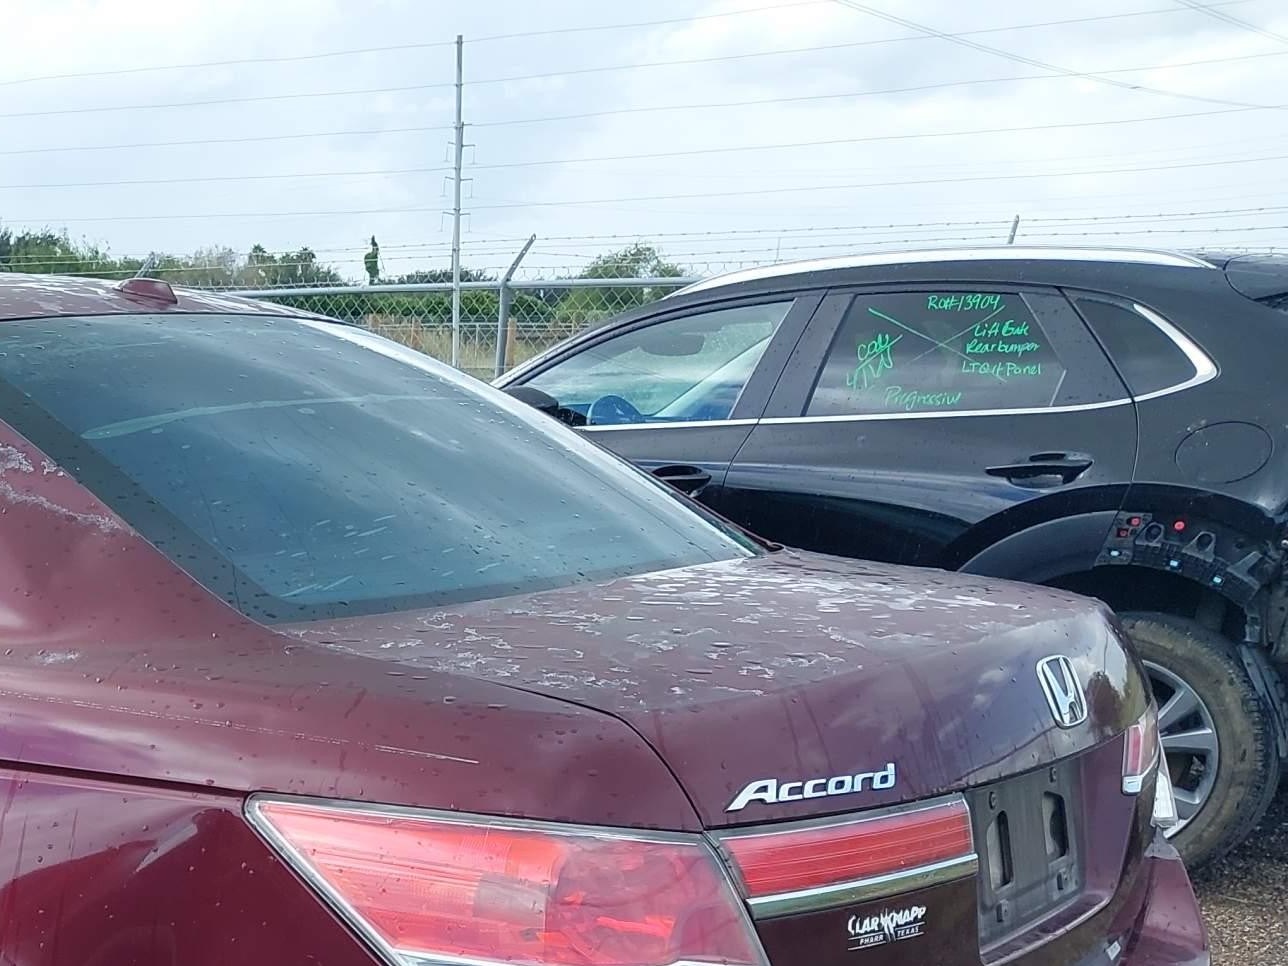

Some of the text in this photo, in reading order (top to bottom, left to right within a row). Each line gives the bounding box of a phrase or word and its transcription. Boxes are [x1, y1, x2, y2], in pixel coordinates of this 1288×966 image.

[725, 763, 896, 812] Accord
[859, 926, 920, 946] PHARR TEXAS
